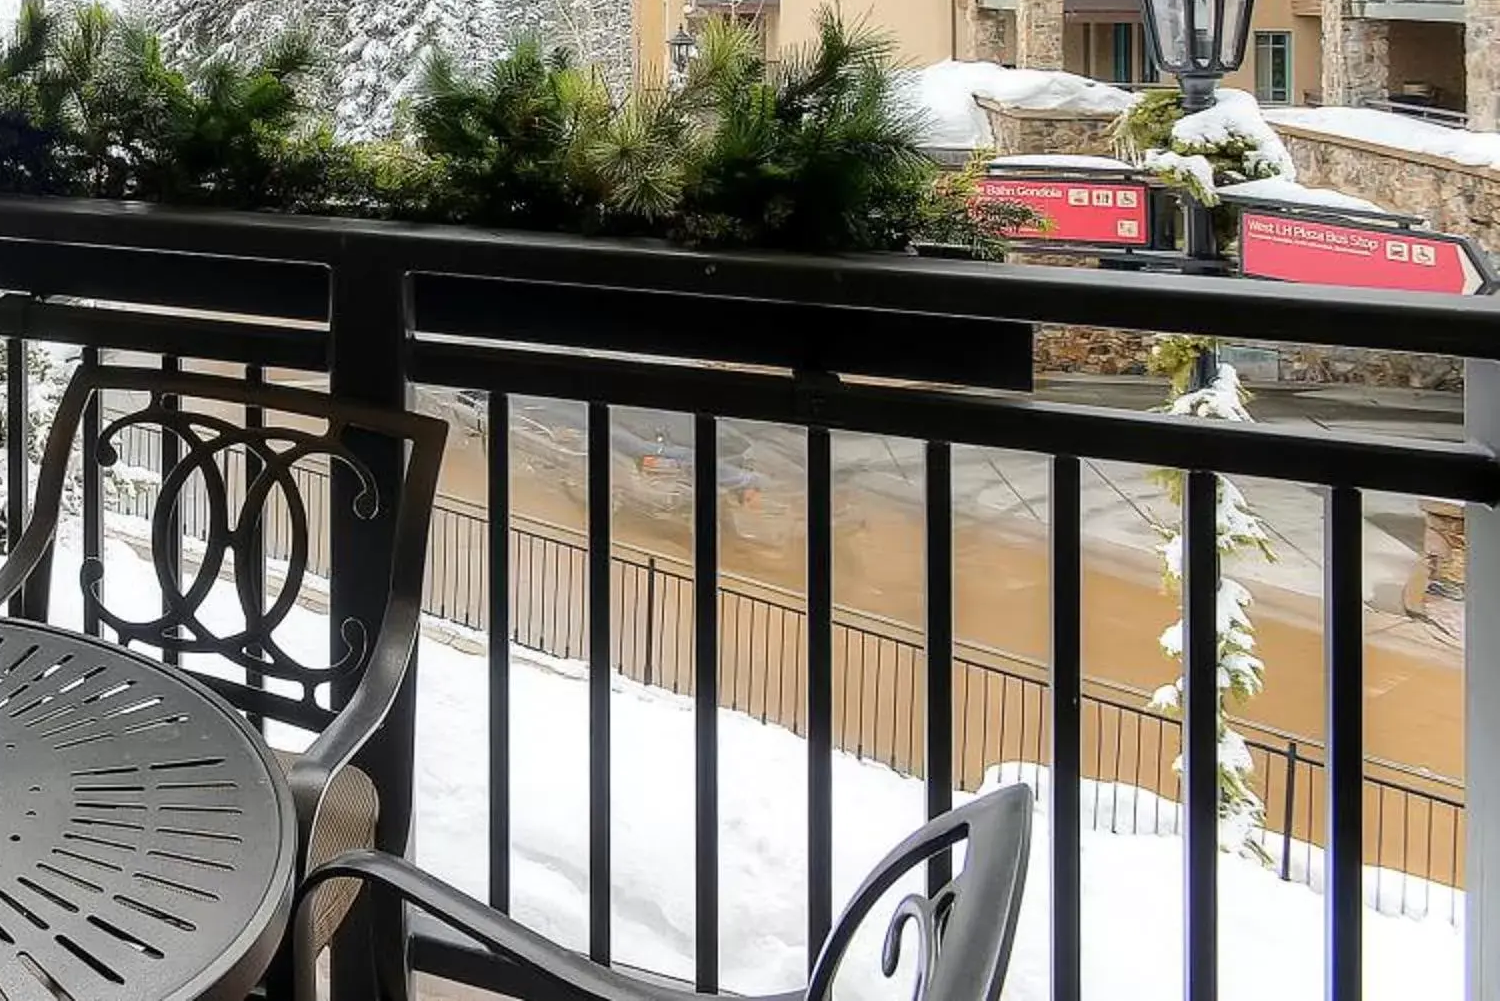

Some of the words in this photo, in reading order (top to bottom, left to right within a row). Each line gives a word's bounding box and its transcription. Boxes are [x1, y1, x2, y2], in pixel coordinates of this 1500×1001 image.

[986, 185, 1016, 197] Bahn
[1017, 186, 1063, 198] Gondola
[1248, 219, 1275, 232] West
[1294, 227, 1325, 242] Plaza
[1326, 231, 1349, 245] Bus
[1350, 234, 1379, 251] Stop
